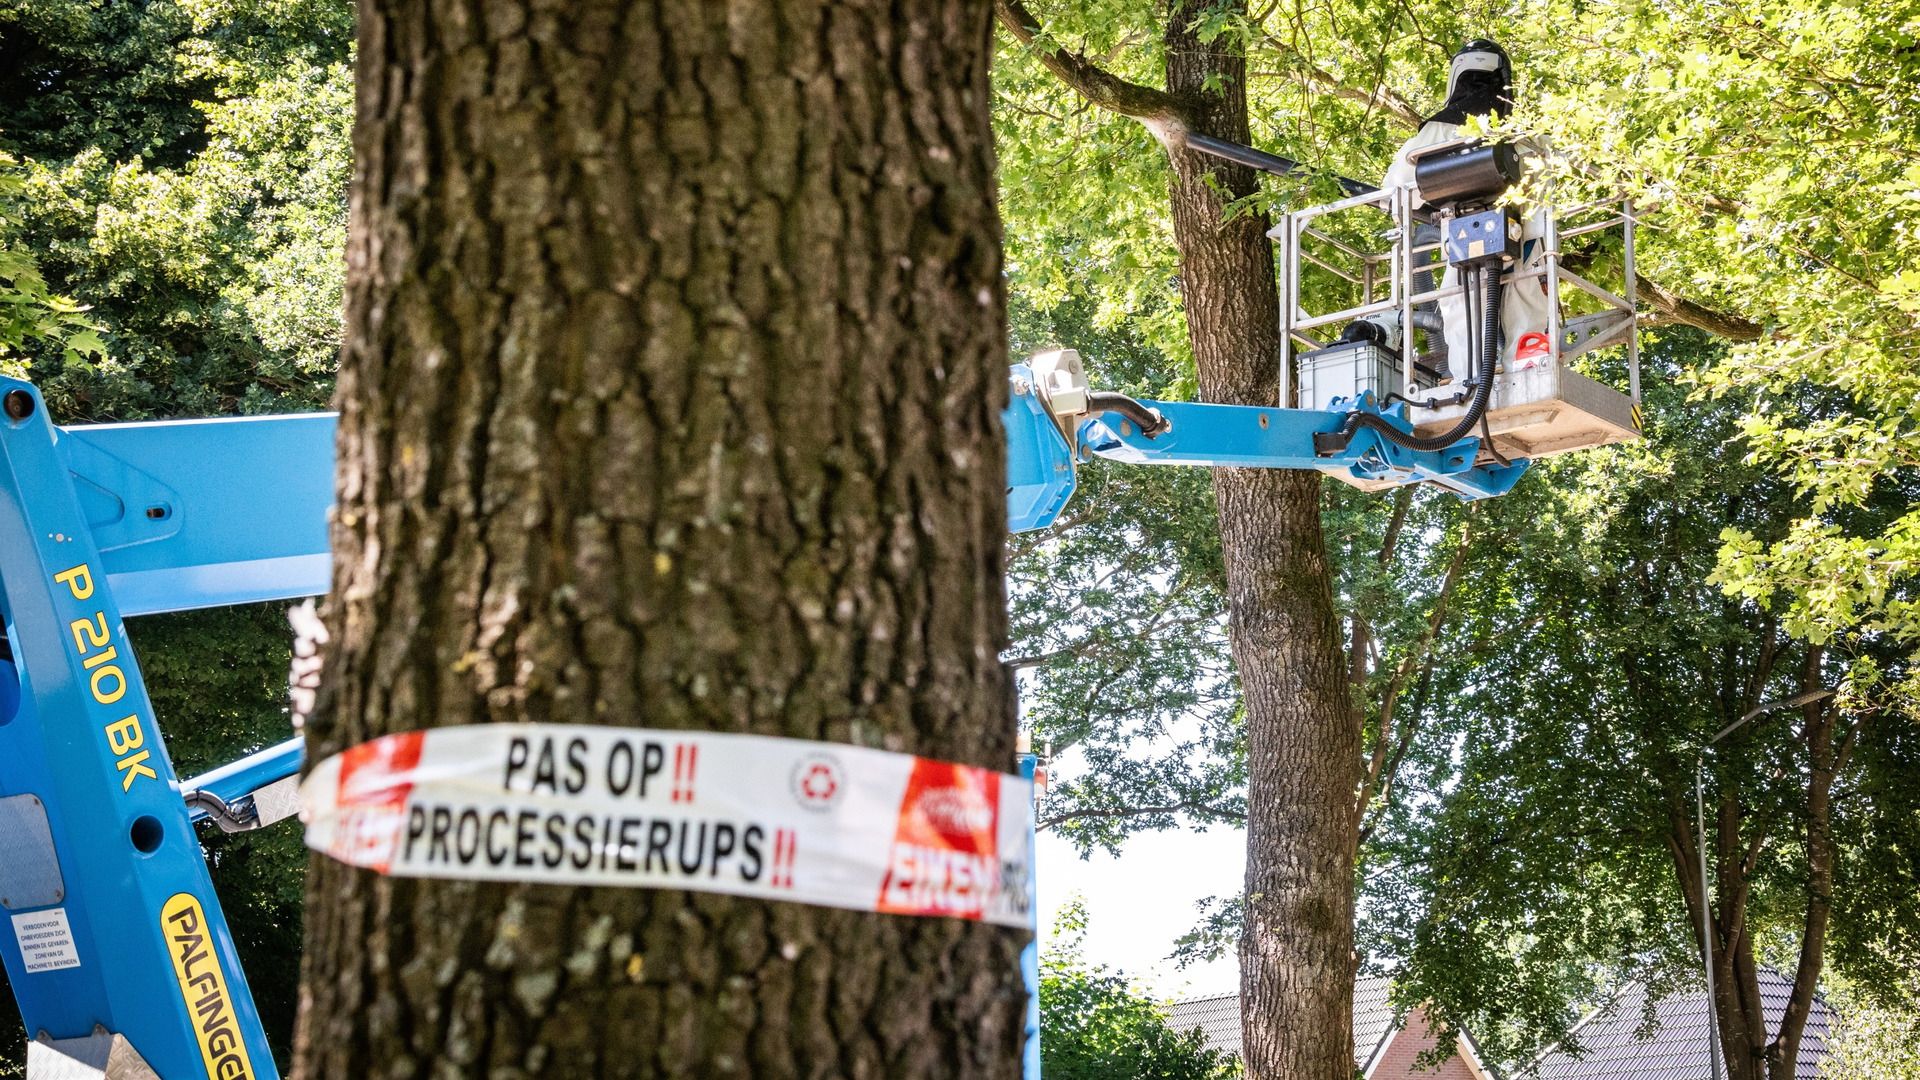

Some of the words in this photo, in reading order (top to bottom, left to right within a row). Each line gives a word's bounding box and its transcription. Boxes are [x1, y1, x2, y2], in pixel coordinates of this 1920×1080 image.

[53, 563, 95, 601] P
[69, 611, 127, 705] 210
[104, 713, 158, 795] BK
[505, 736, 588, 795] PAS
[606, 740, 697, 803] OP!!
[404, 804, 795, 889] PROCESSIERUPS!!
[21, 932, 54, 941] ONBEVOEGDEN
[167, 905, 247, 1080] PALFINGE
